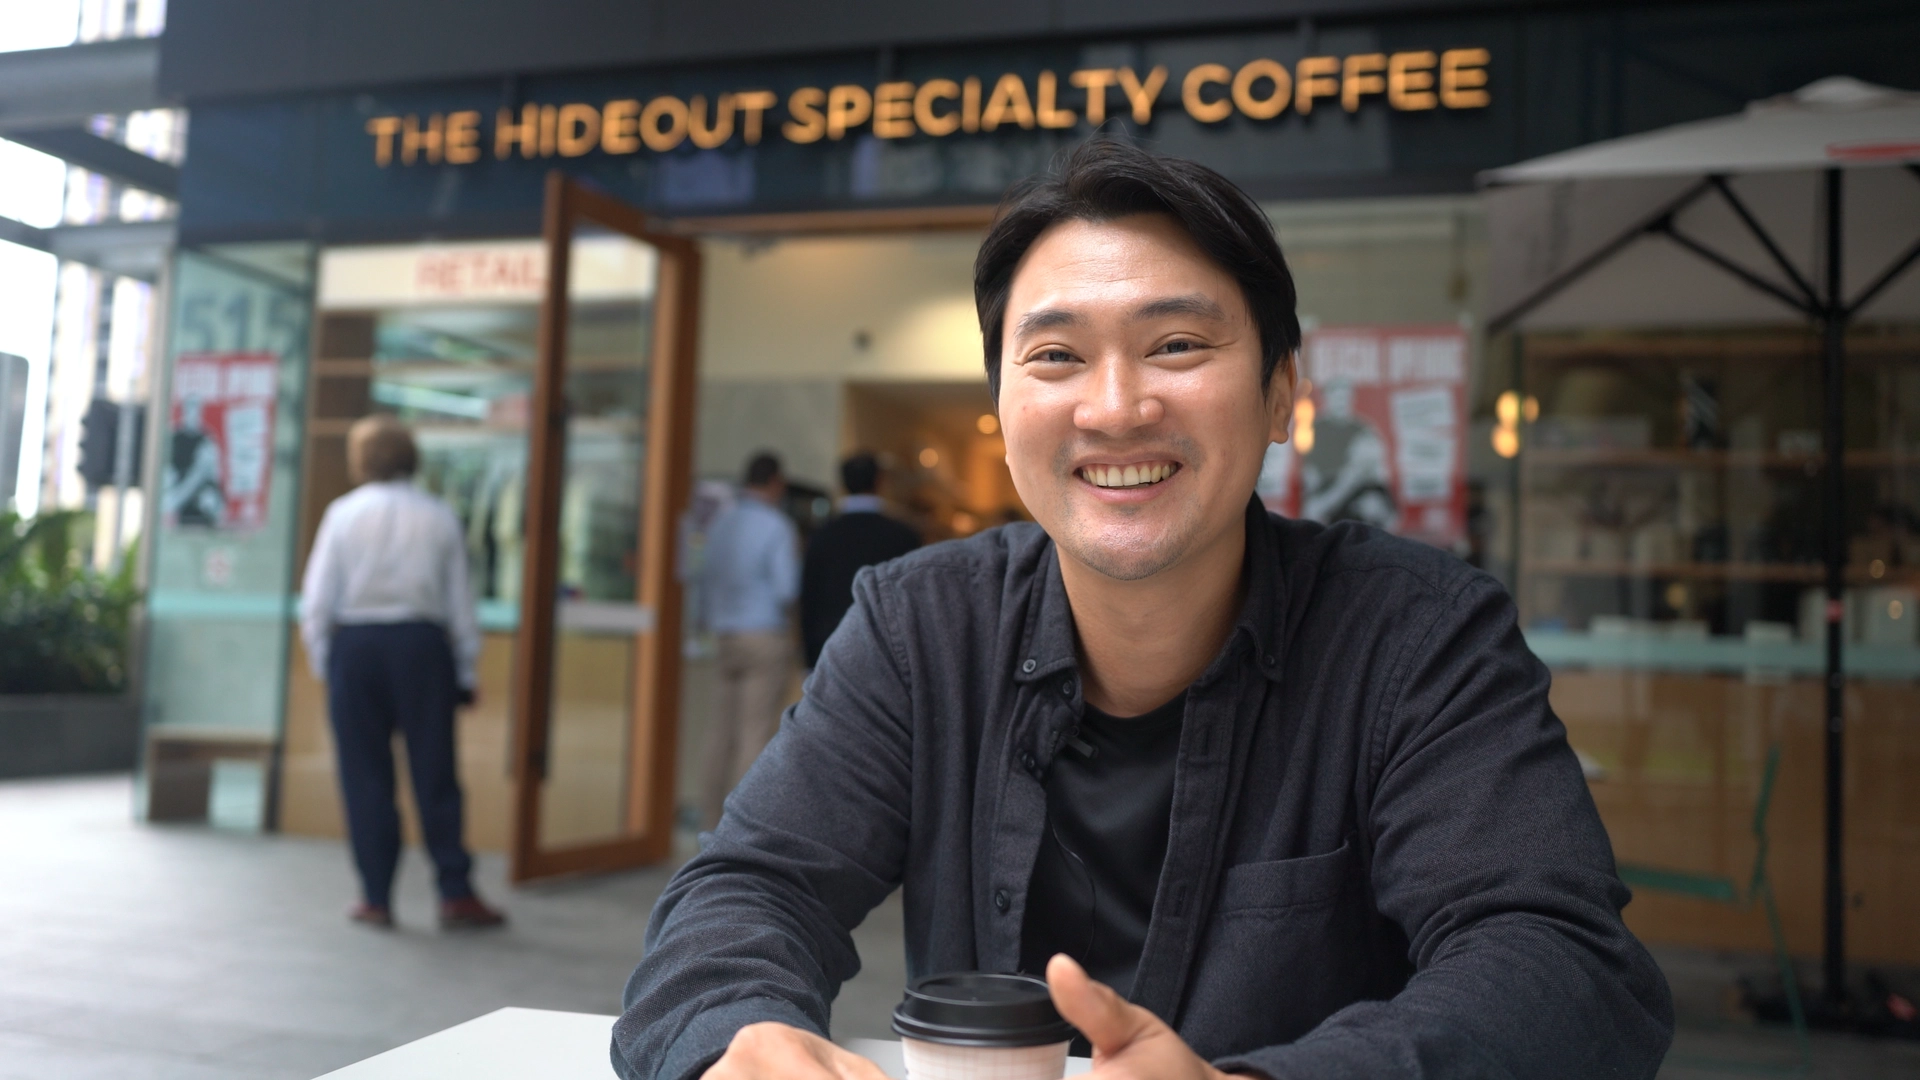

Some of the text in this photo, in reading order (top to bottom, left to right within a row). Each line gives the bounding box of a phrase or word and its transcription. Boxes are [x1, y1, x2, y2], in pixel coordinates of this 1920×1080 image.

[366, 48, 1492, 168] THE HIDEOUT SPECIALTY COFFEE
[415, 252, 545, 288] RETAIL
